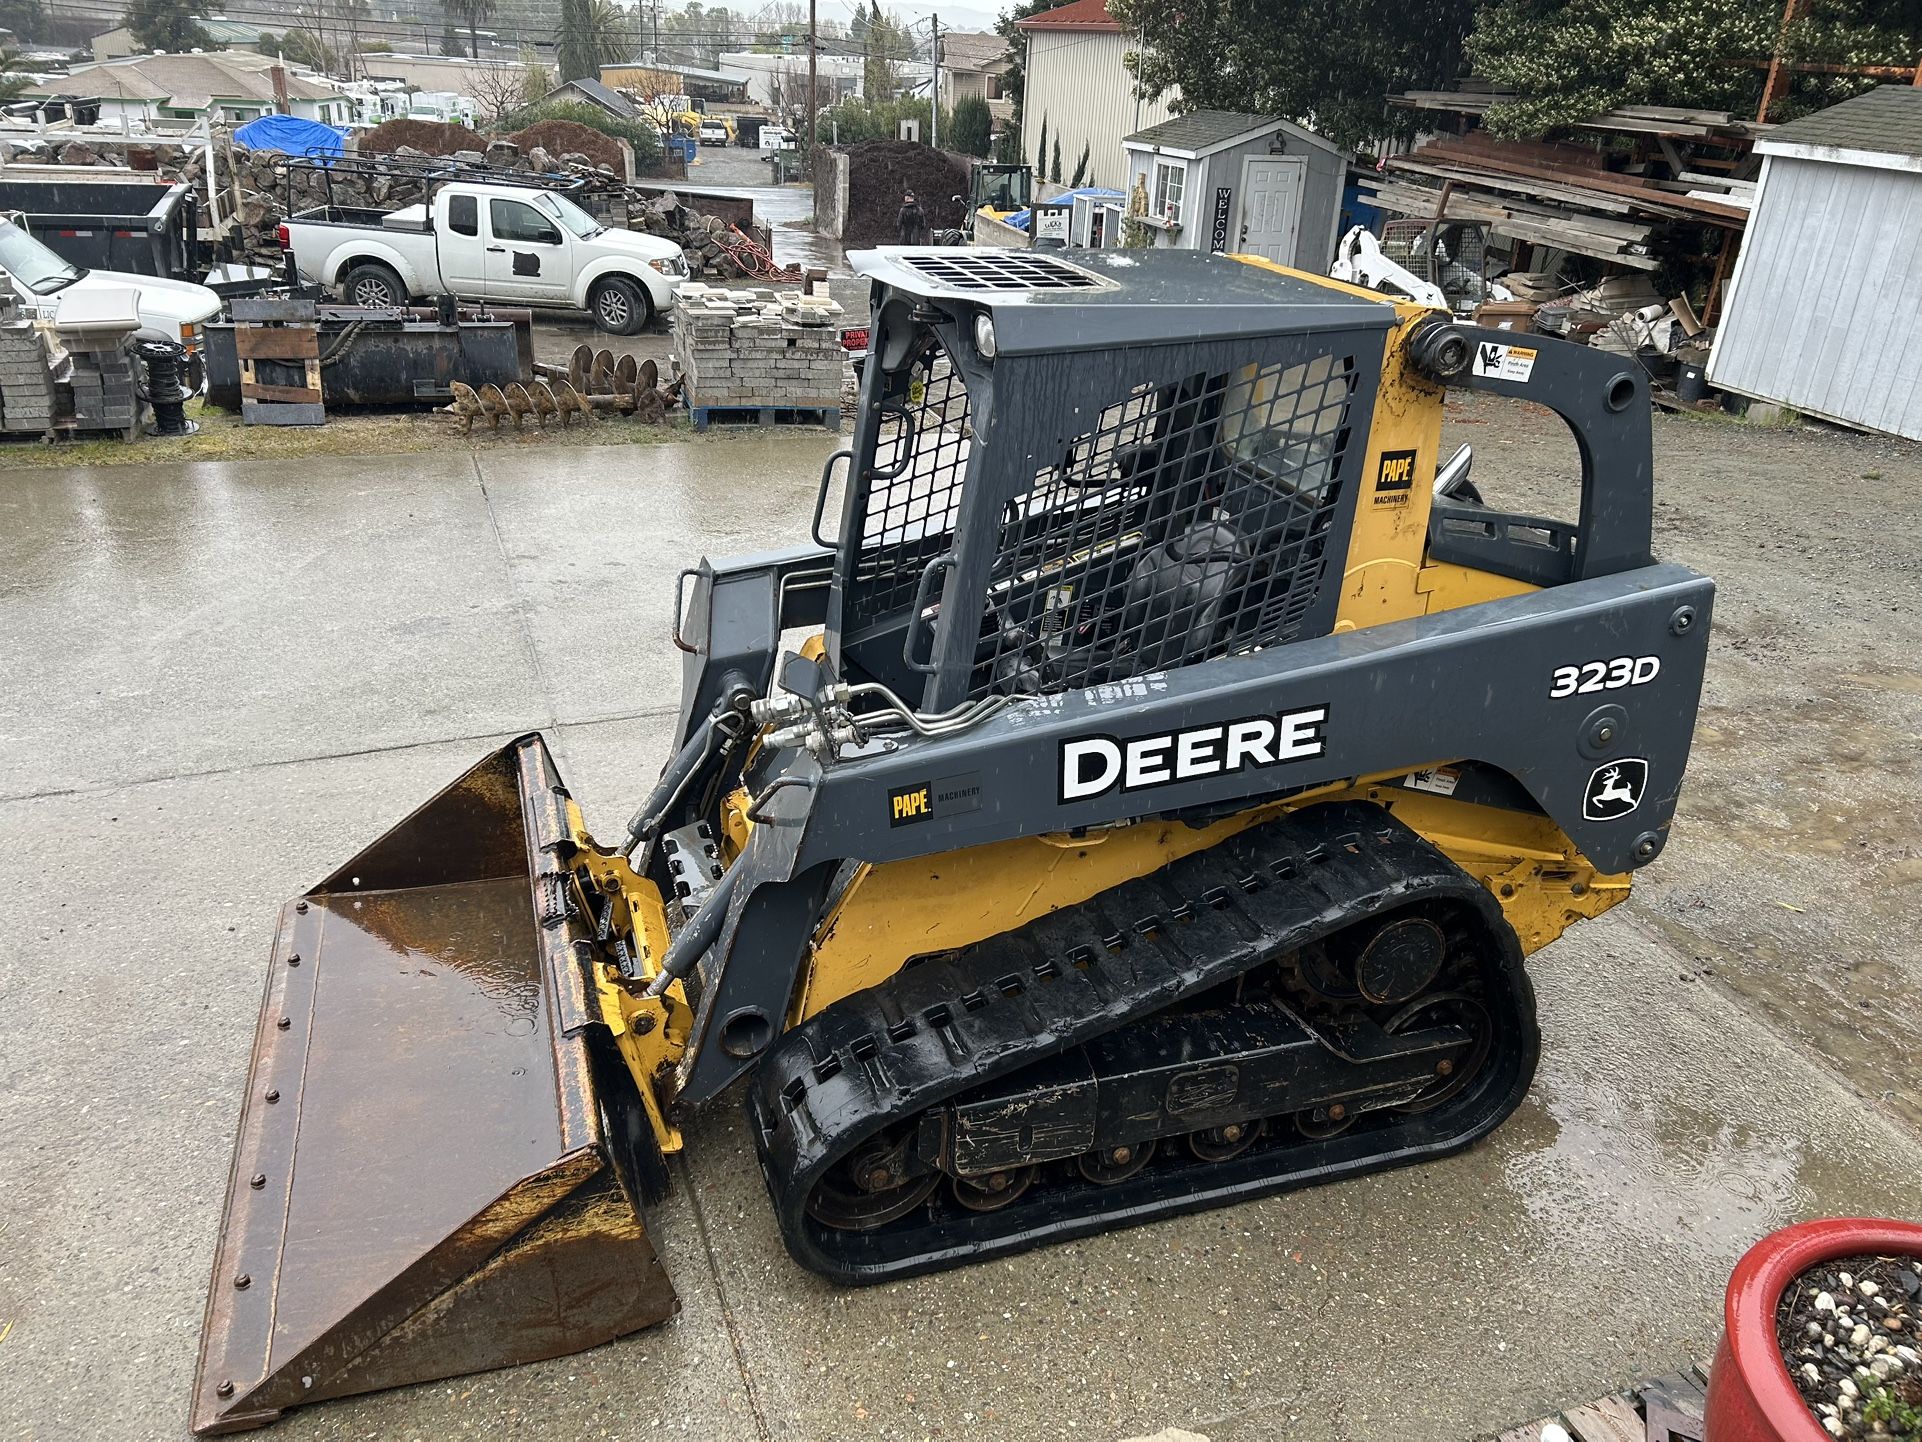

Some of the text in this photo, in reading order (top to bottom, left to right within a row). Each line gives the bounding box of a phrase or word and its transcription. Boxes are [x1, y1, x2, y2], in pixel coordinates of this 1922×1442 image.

[1213, 189, 1231, 251] WELCOM
[842, 337, 869, 347] PROPER
[845, 330, 869, 339] PRIVAT
[1374, 494, 1409, 504] MACHINERY
[1549, 655, 1662, 698] 323D
[1062, 708, 1326, 800] DEERE
[937, 786, 980, 802] MACHINERY
